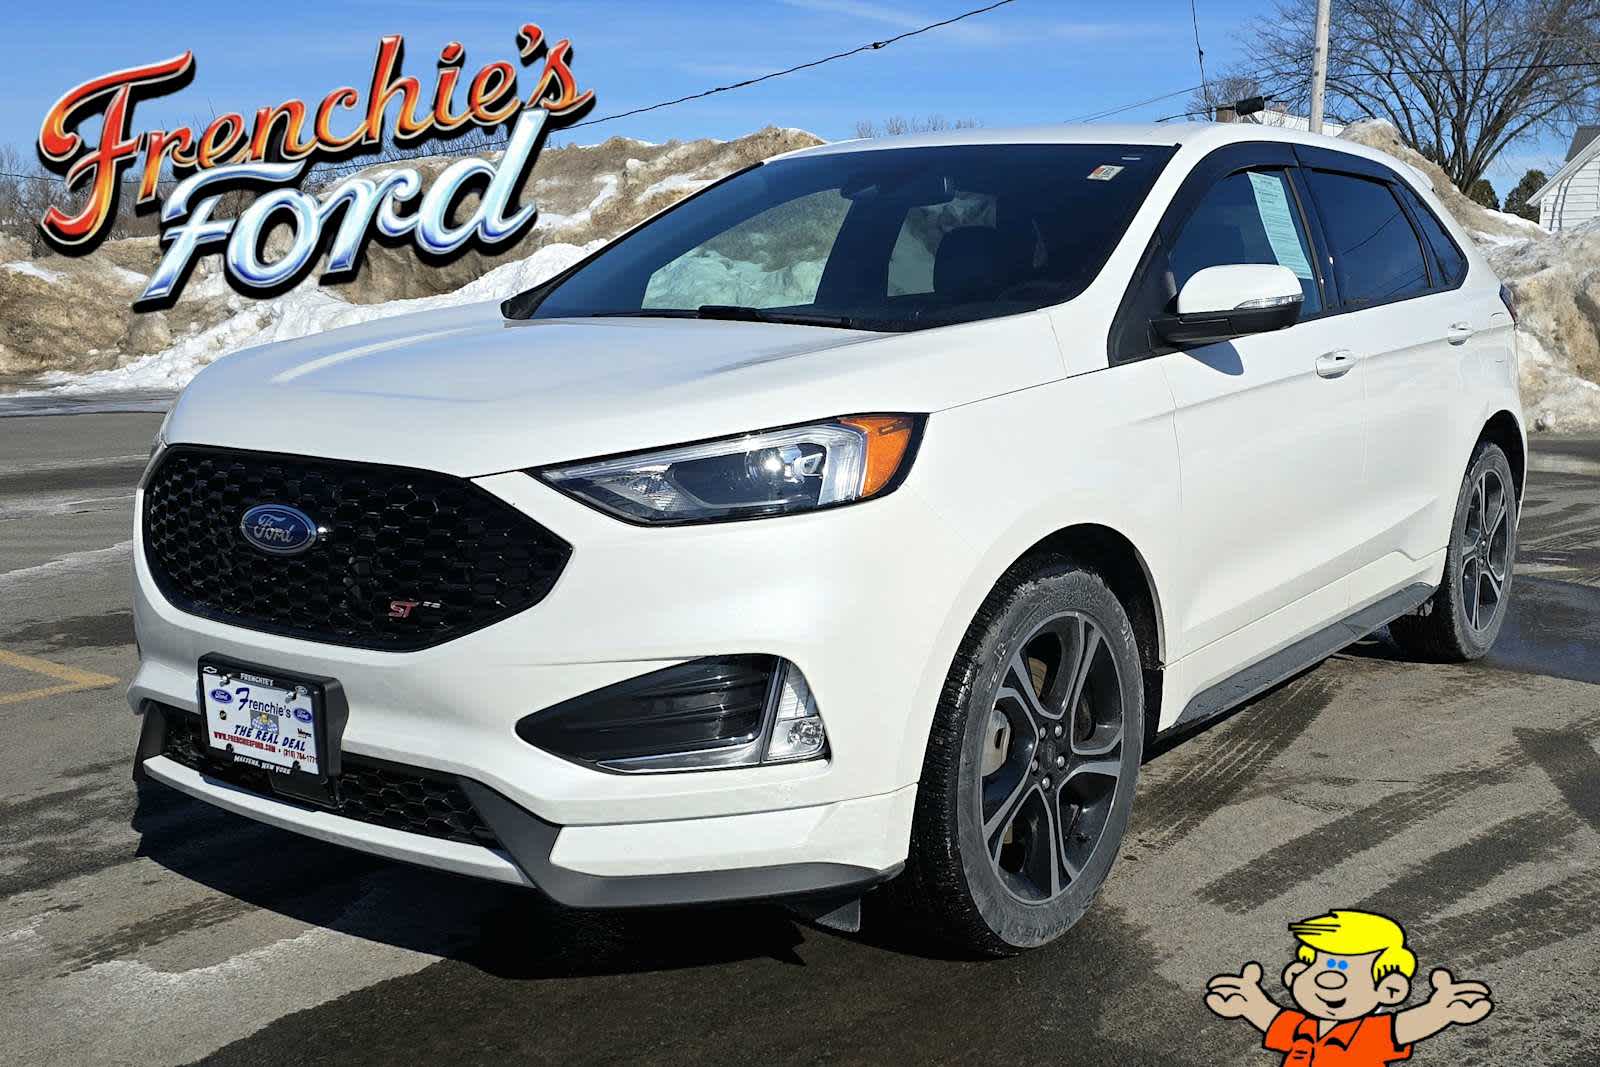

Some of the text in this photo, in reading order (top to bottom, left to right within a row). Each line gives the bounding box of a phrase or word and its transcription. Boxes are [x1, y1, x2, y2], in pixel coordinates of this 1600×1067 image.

[253, 513, 296, 543] Ford
[388, 600, 417, 618] ST
[236, 687, 291, 719] Frenchie's
[234, 724, 305, 751] THE REAL DEAL
